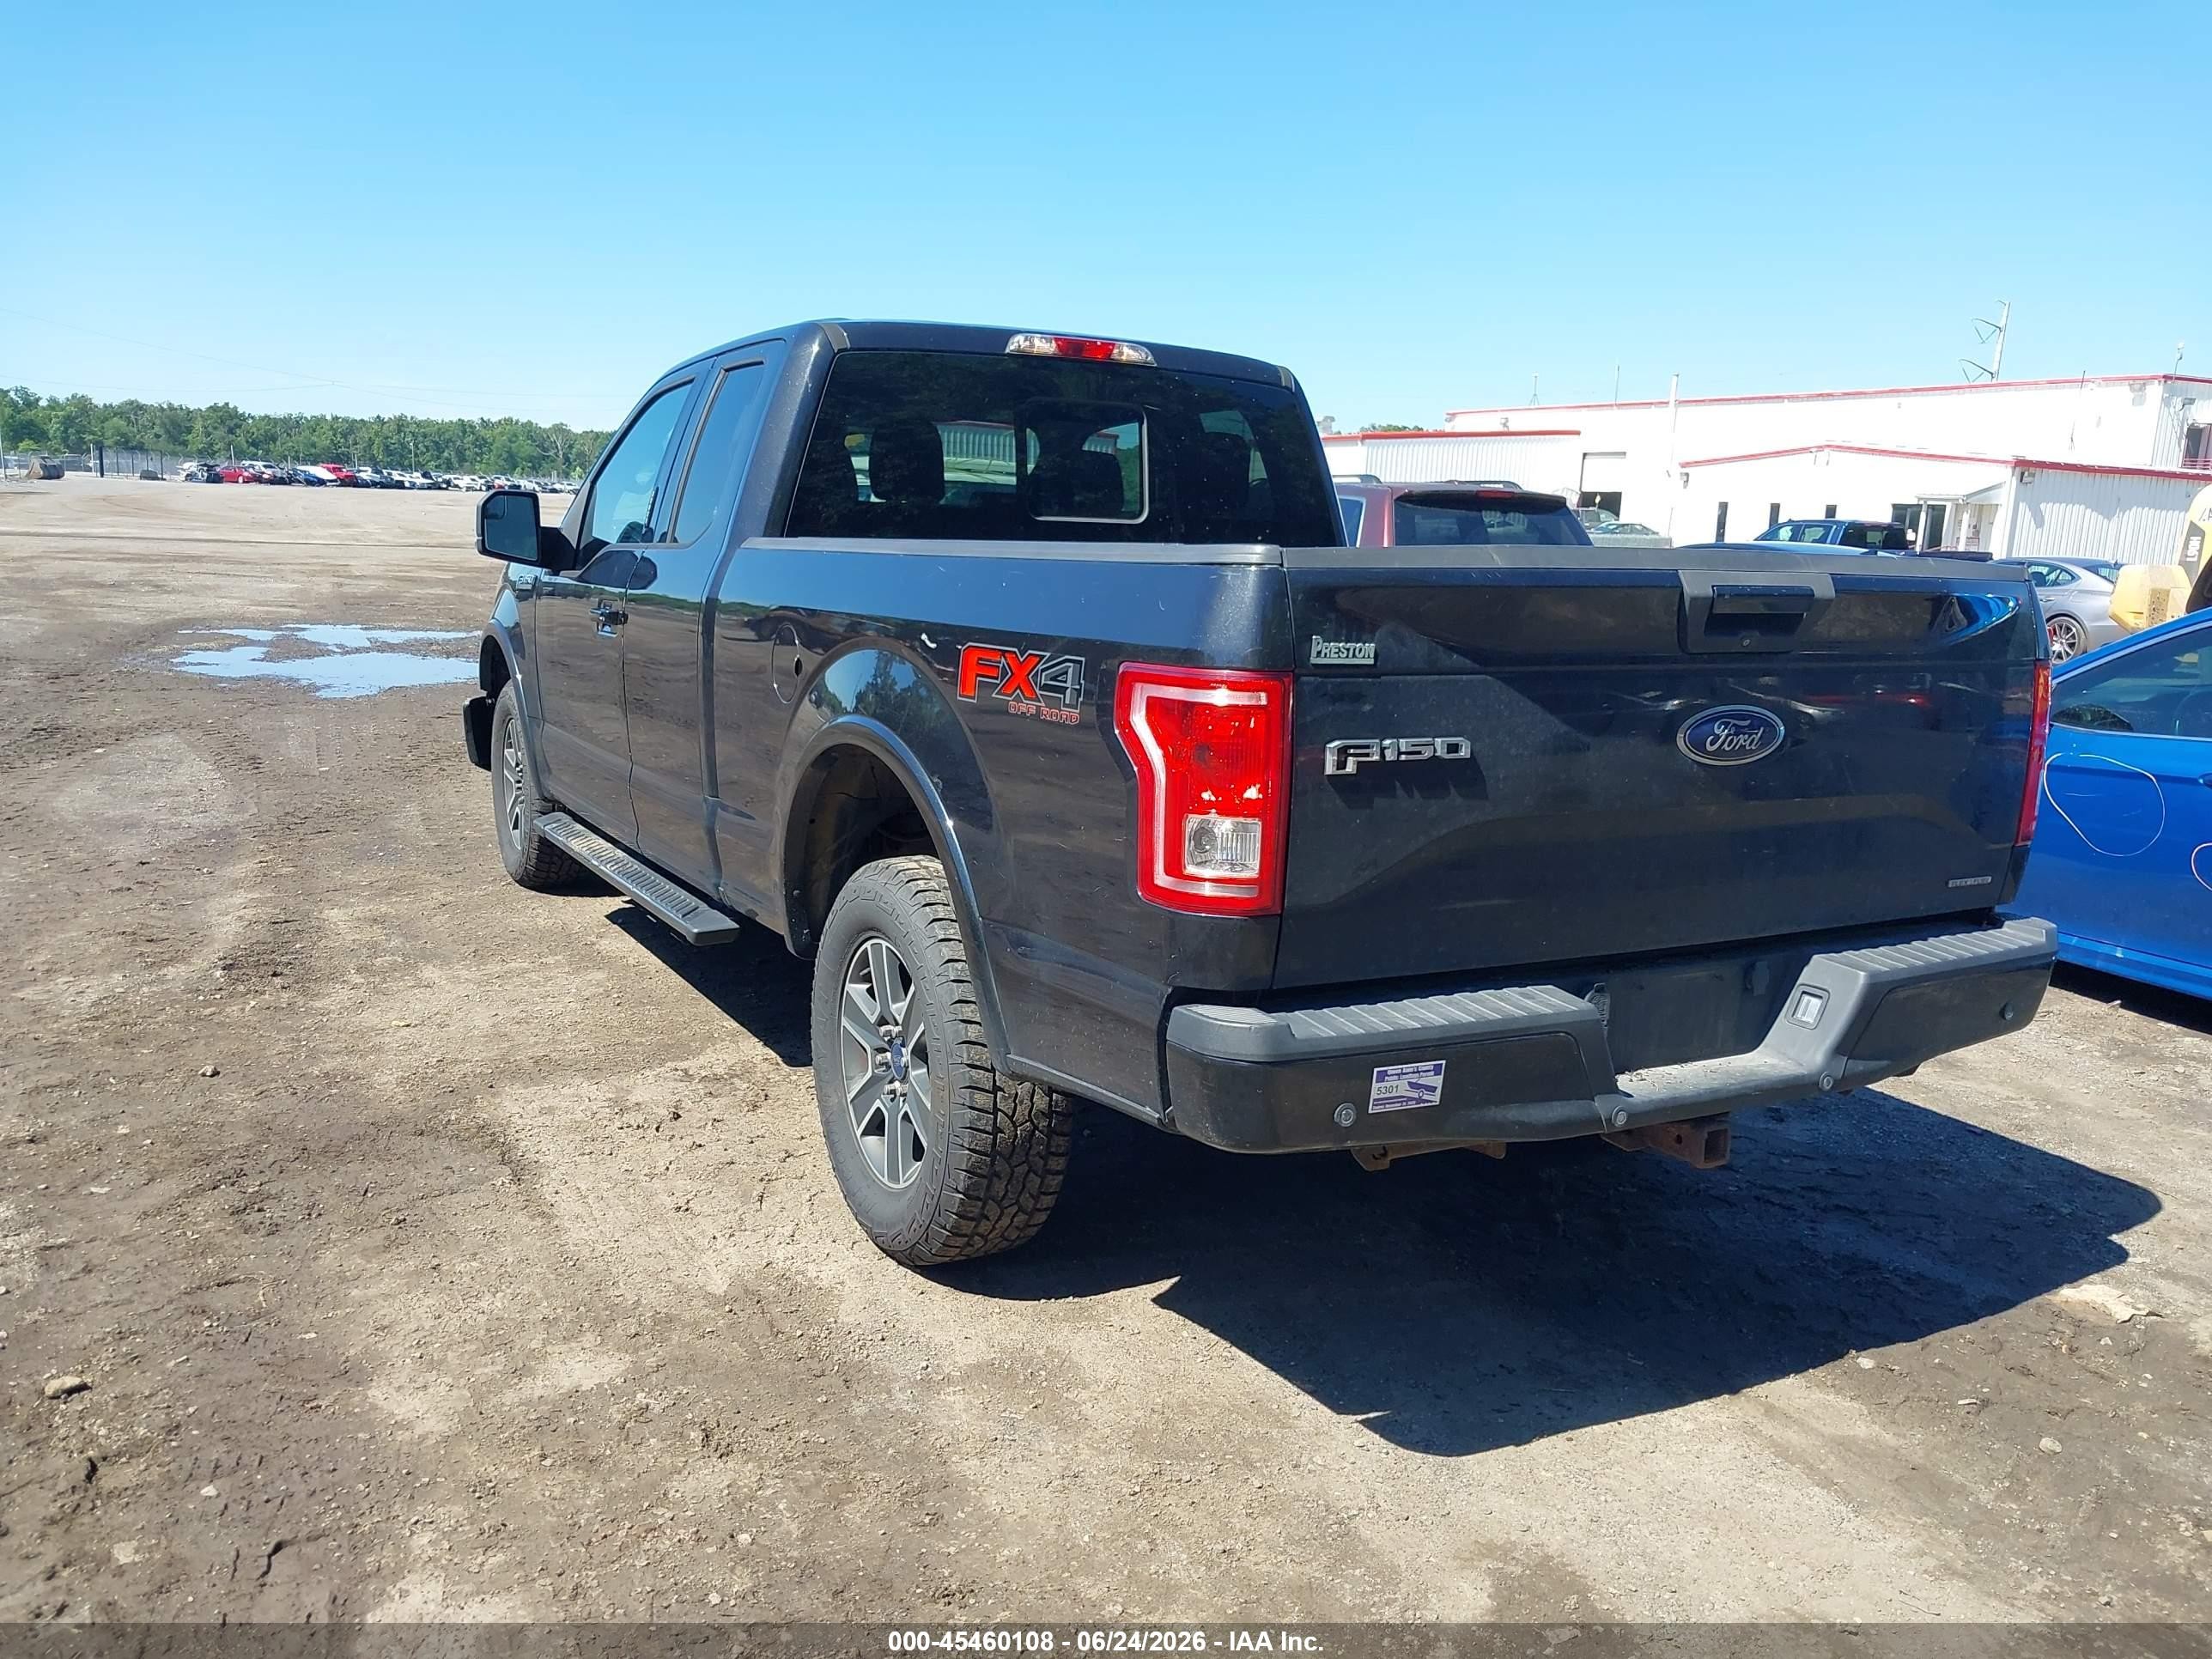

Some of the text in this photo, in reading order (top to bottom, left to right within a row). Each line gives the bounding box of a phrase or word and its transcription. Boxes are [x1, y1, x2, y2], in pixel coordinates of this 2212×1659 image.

[1311, 635, 1375, 659] PRESTON
[957, 641, 1085, 713] FX4
[1008, 701, 1079, 725] OFF ROAD
[1705, 718, 1764, 751] Ford
[1376, 1085, 1400, 1096] 5301
